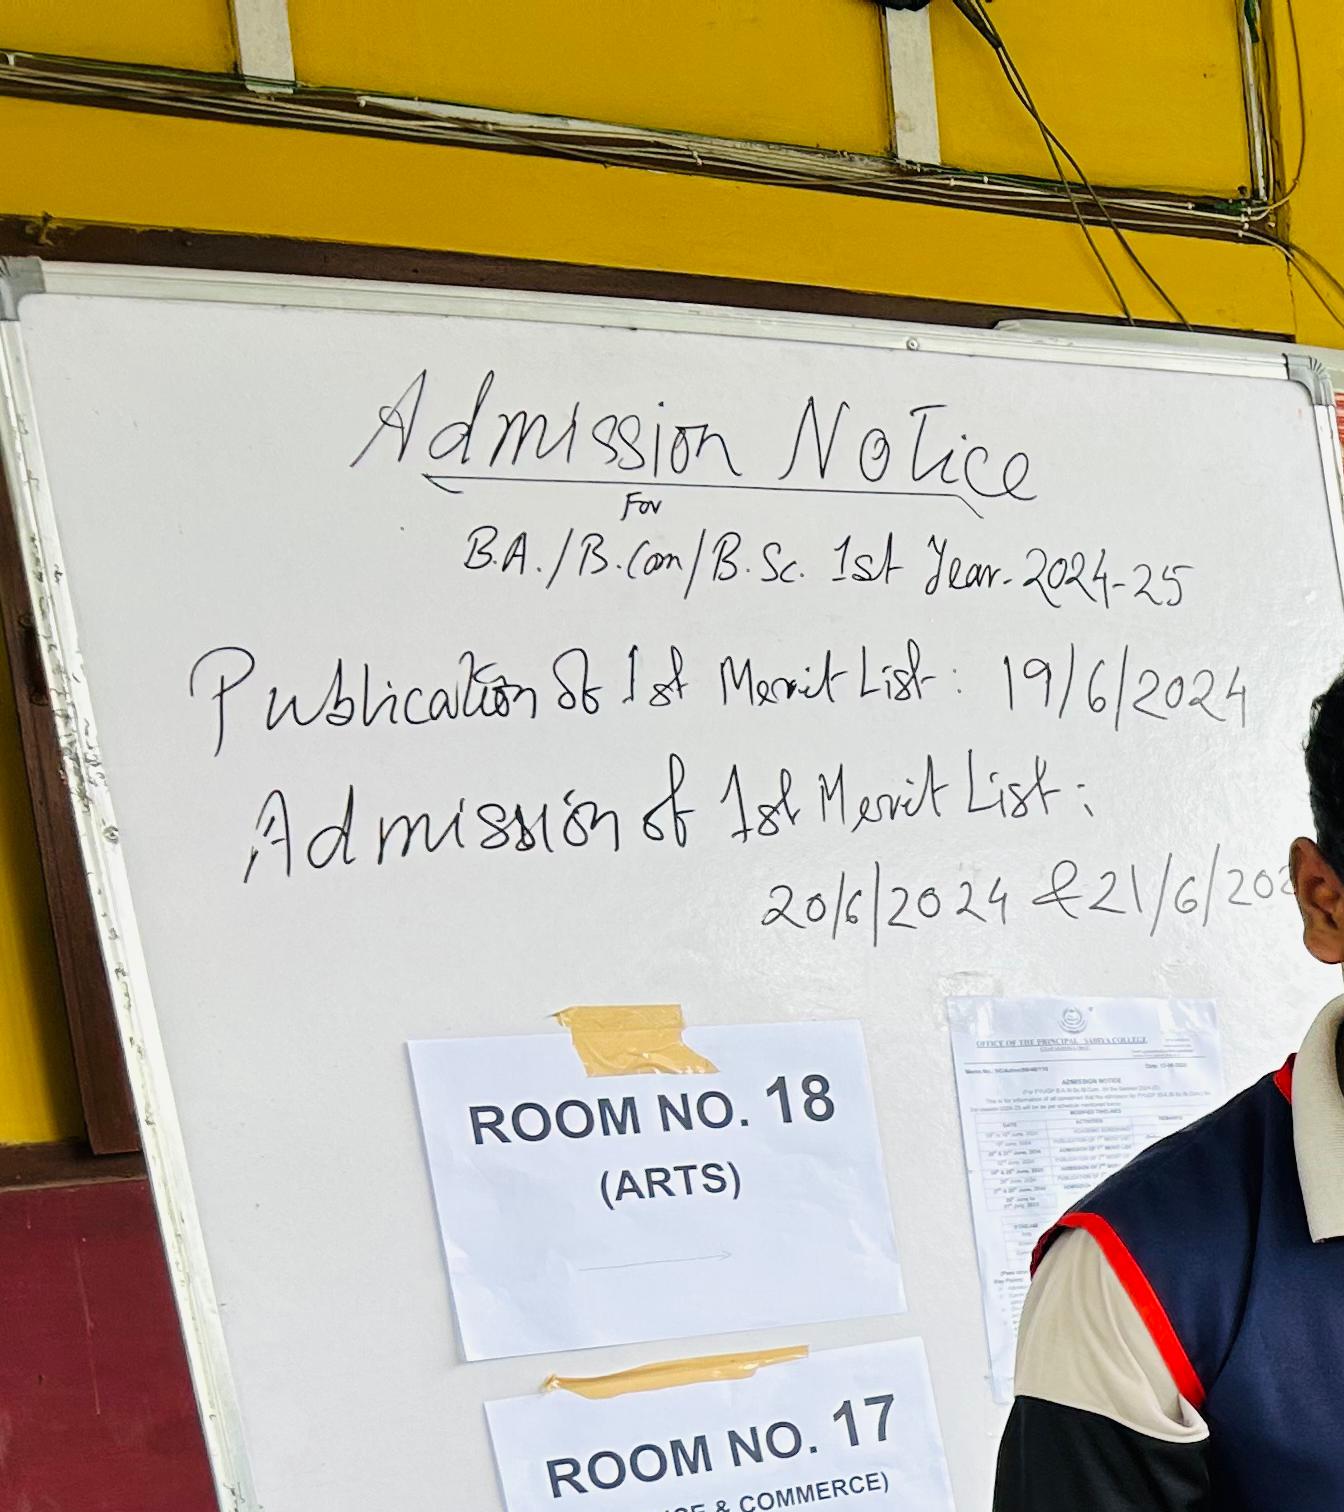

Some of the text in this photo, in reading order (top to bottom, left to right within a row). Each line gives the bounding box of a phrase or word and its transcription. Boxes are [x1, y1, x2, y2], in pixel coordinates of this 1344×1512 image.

[350, 368, 1038, 502] Admission Notice
[621, 492, 663, 522] For
[832, 540, 902, 584] 1st
[188, 645, 537, 756] Publication
[622, 645, 688, 707] 1st
[721, 649, 846, 707] Merit
[1003, 643, 1248, 732] 19/6/2024
[243, 786, 620, 884] Admission
[641, 754, 696, 842] of
[818, 756, 949, 834] Merit
[762, 860, 1008, 948] 20/6/2024
[1088, 843, 1295, 938] 21/6/202
[467, 1072, 837, 1147] ROOM NO. 18
[598, 1159, 742, 1212] (ARTS)
[544, 1392, 897, 1499] ROOM NO. 17
